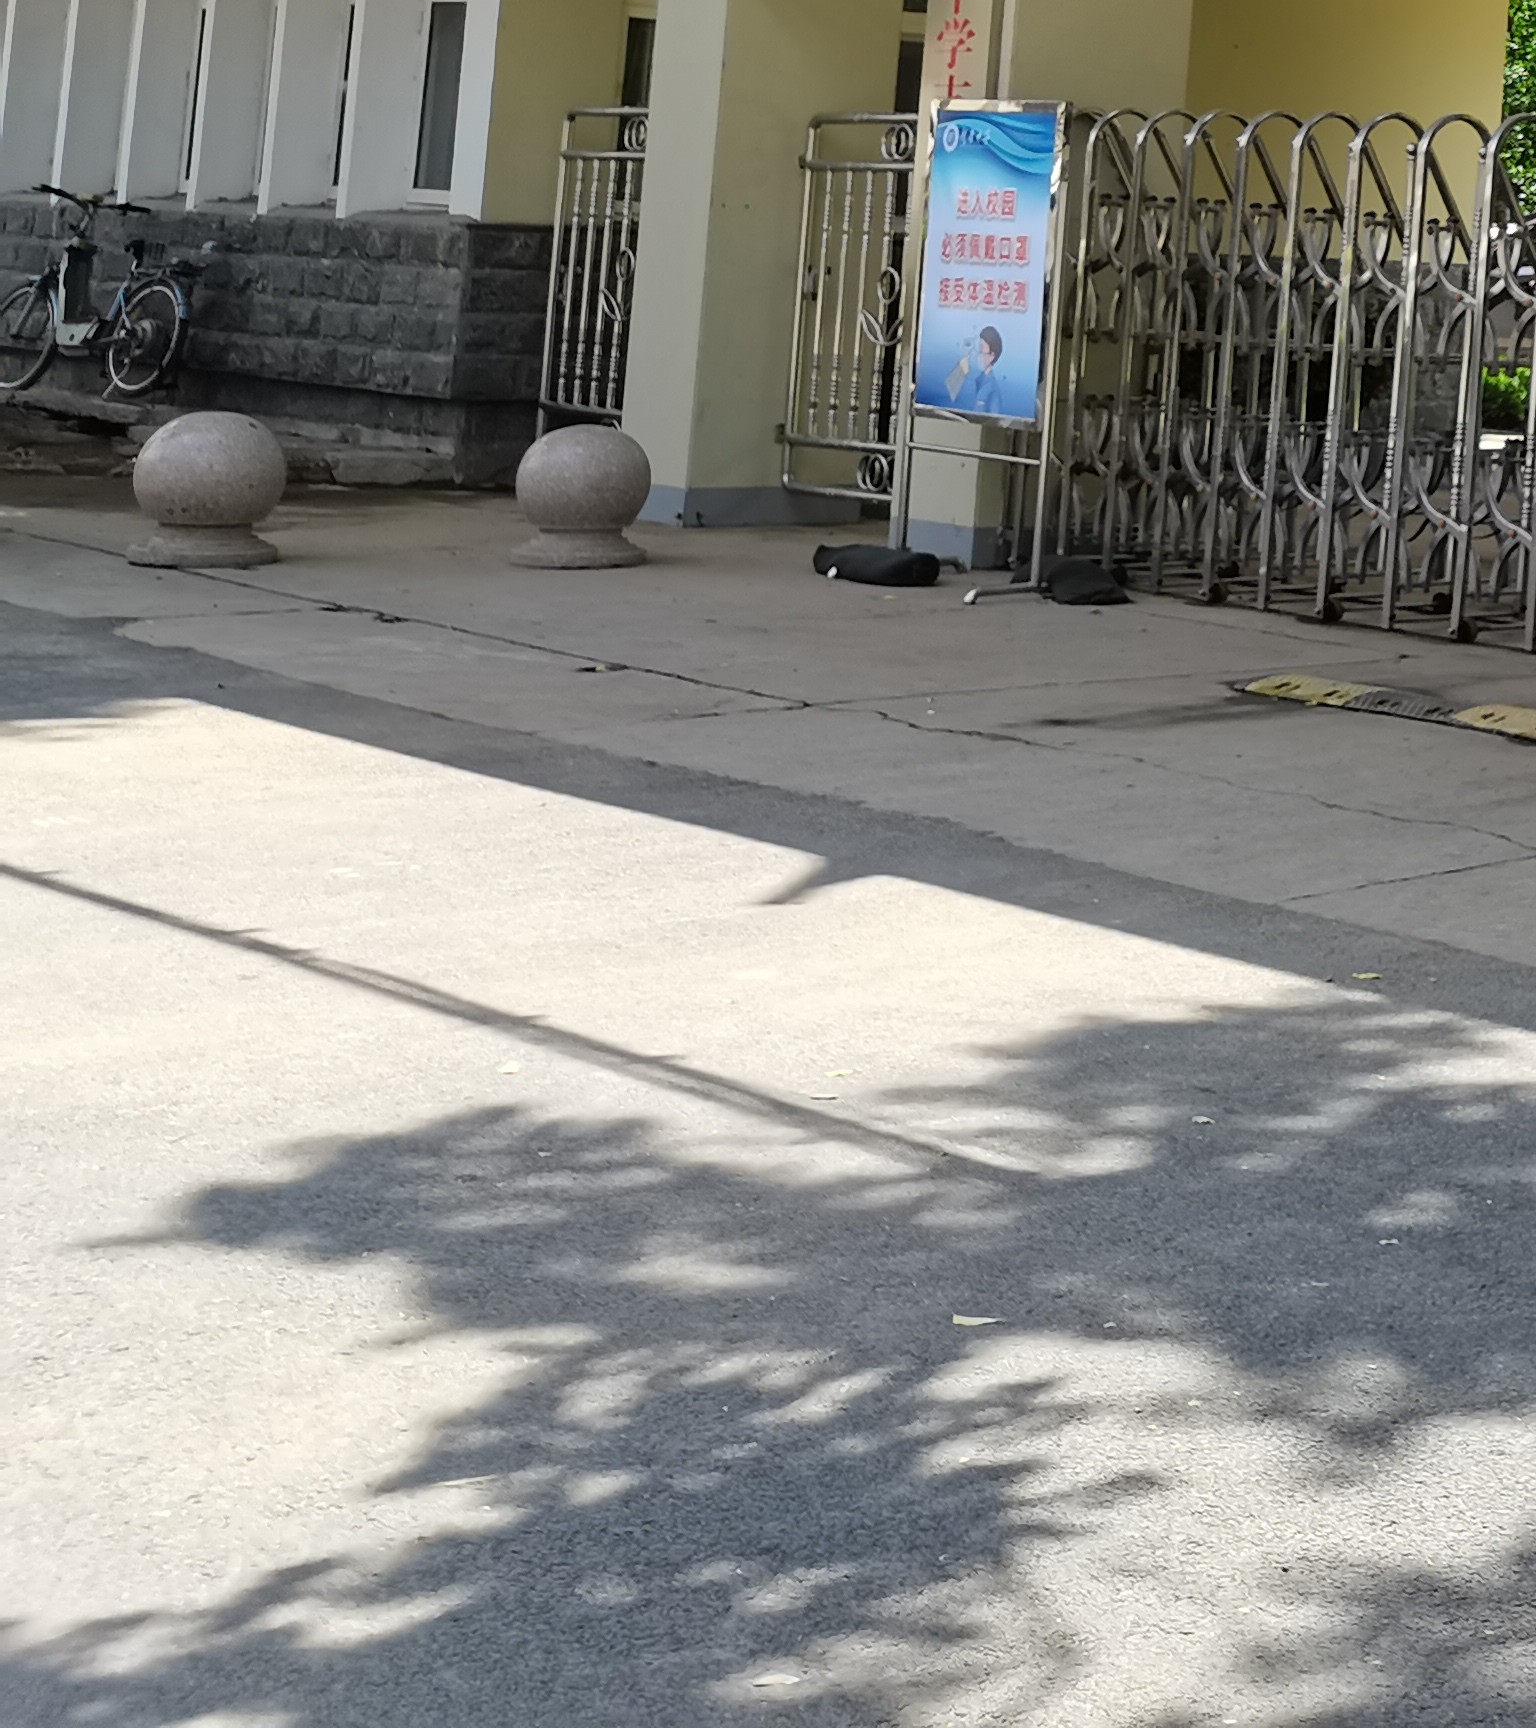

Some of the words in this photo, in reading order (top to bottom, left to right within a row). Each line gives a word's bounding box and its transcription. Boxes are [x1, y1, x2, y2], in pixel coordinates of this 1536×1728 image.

[956, 187, 1017, 219] 进入校园
[940, 231, 1031, 264] 必须佩戴口罩
[937, 276, 1029, 311] 接受体温检测
